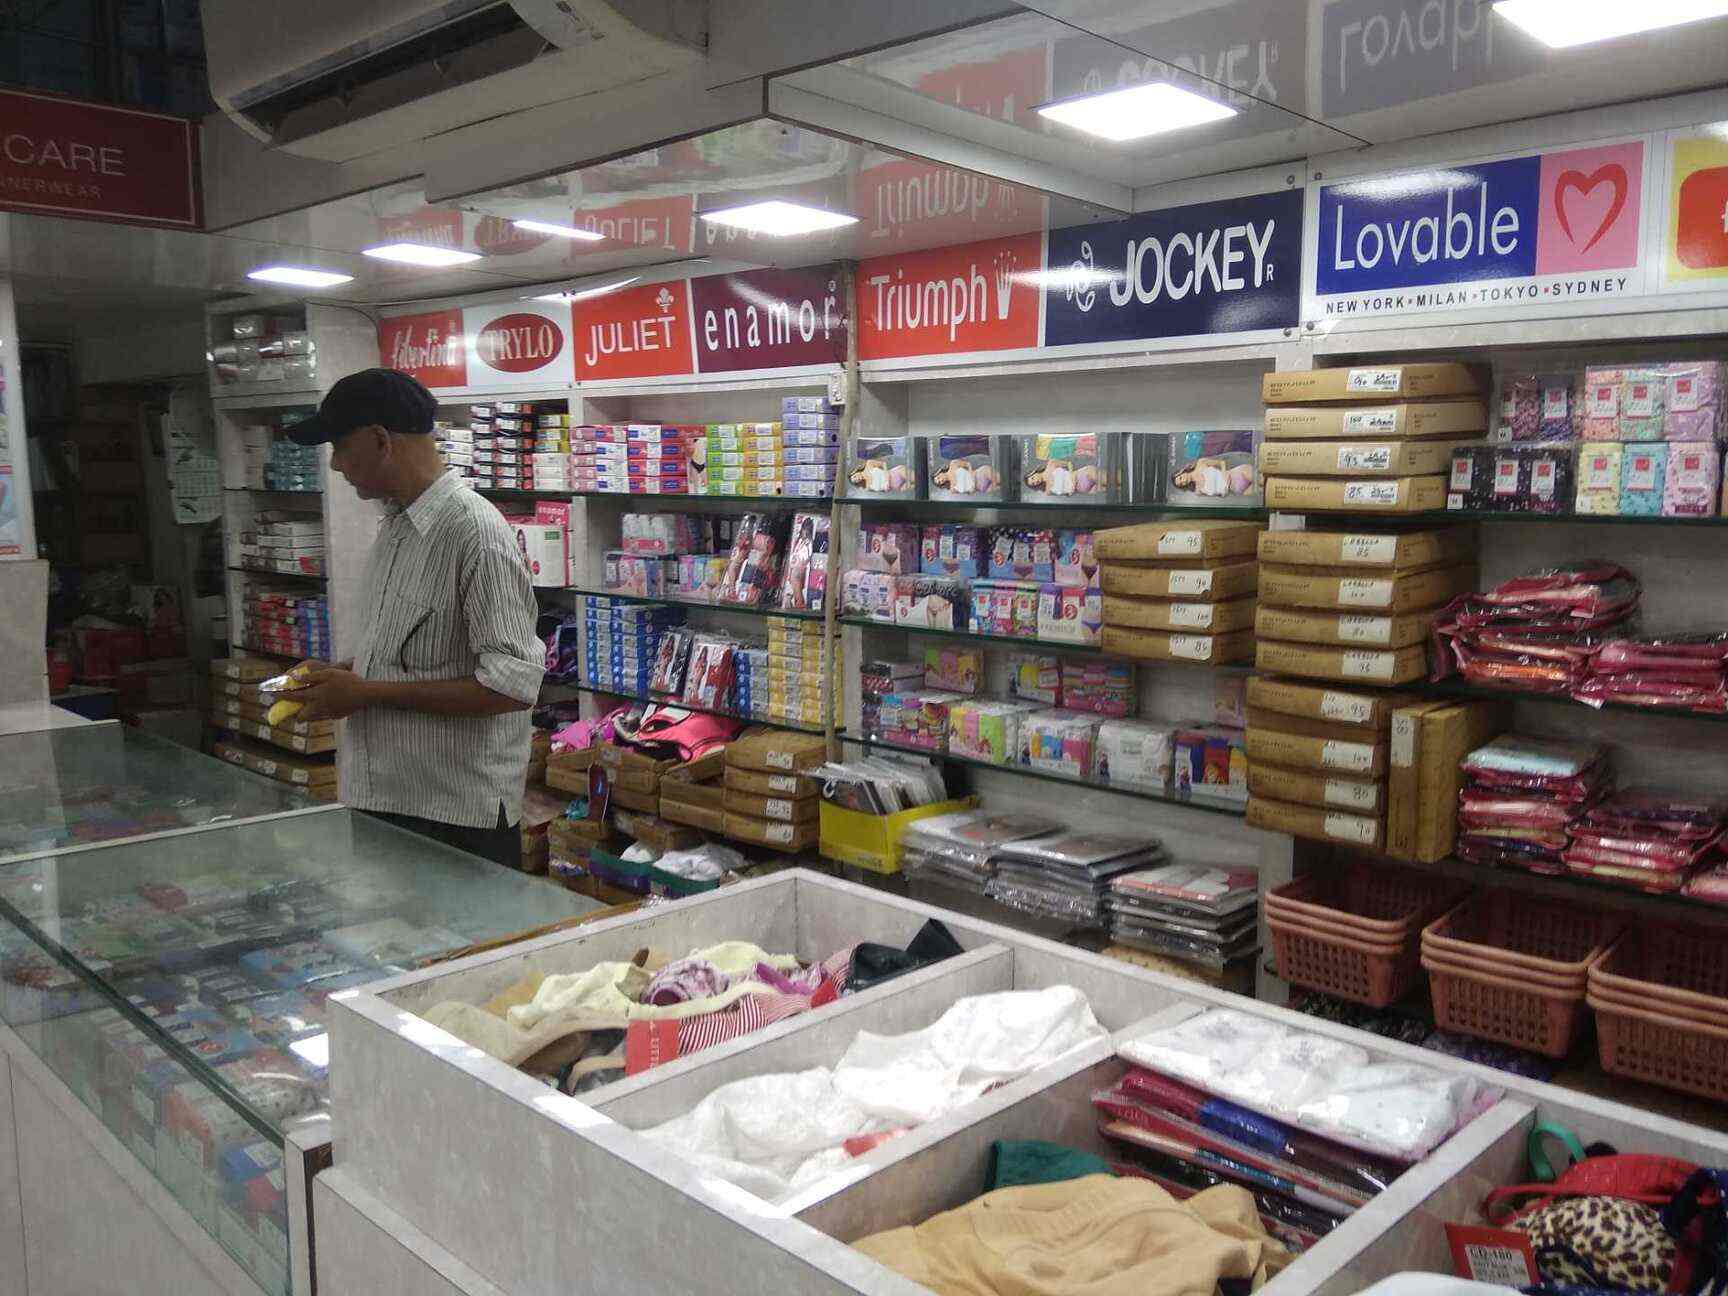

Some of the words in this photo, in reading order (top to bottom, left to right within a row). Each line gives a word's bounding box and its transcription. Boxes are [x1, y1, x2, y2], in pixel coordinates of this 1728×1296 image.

[4, 134, 127, 177] CARE
[1335, 181, 1520, 271] Lovable
[1109, 219, 1275, 307] JOCKEY
[704, 294, 837, 352] enamor
[871, 263, 988, 341] Triumph
[1326, 299, 1357, 314] NEW
[1363, 296, 1405, 312] YORK
[1416, 290, 1467, 307] MILAN
[1480, 284, 1539, 303] TOKYO
[1552, 277, 1627, 296] SYDNEY
[484, 324, 554, 362] TRYLO
[584, 315, 676, 367] JULIET
